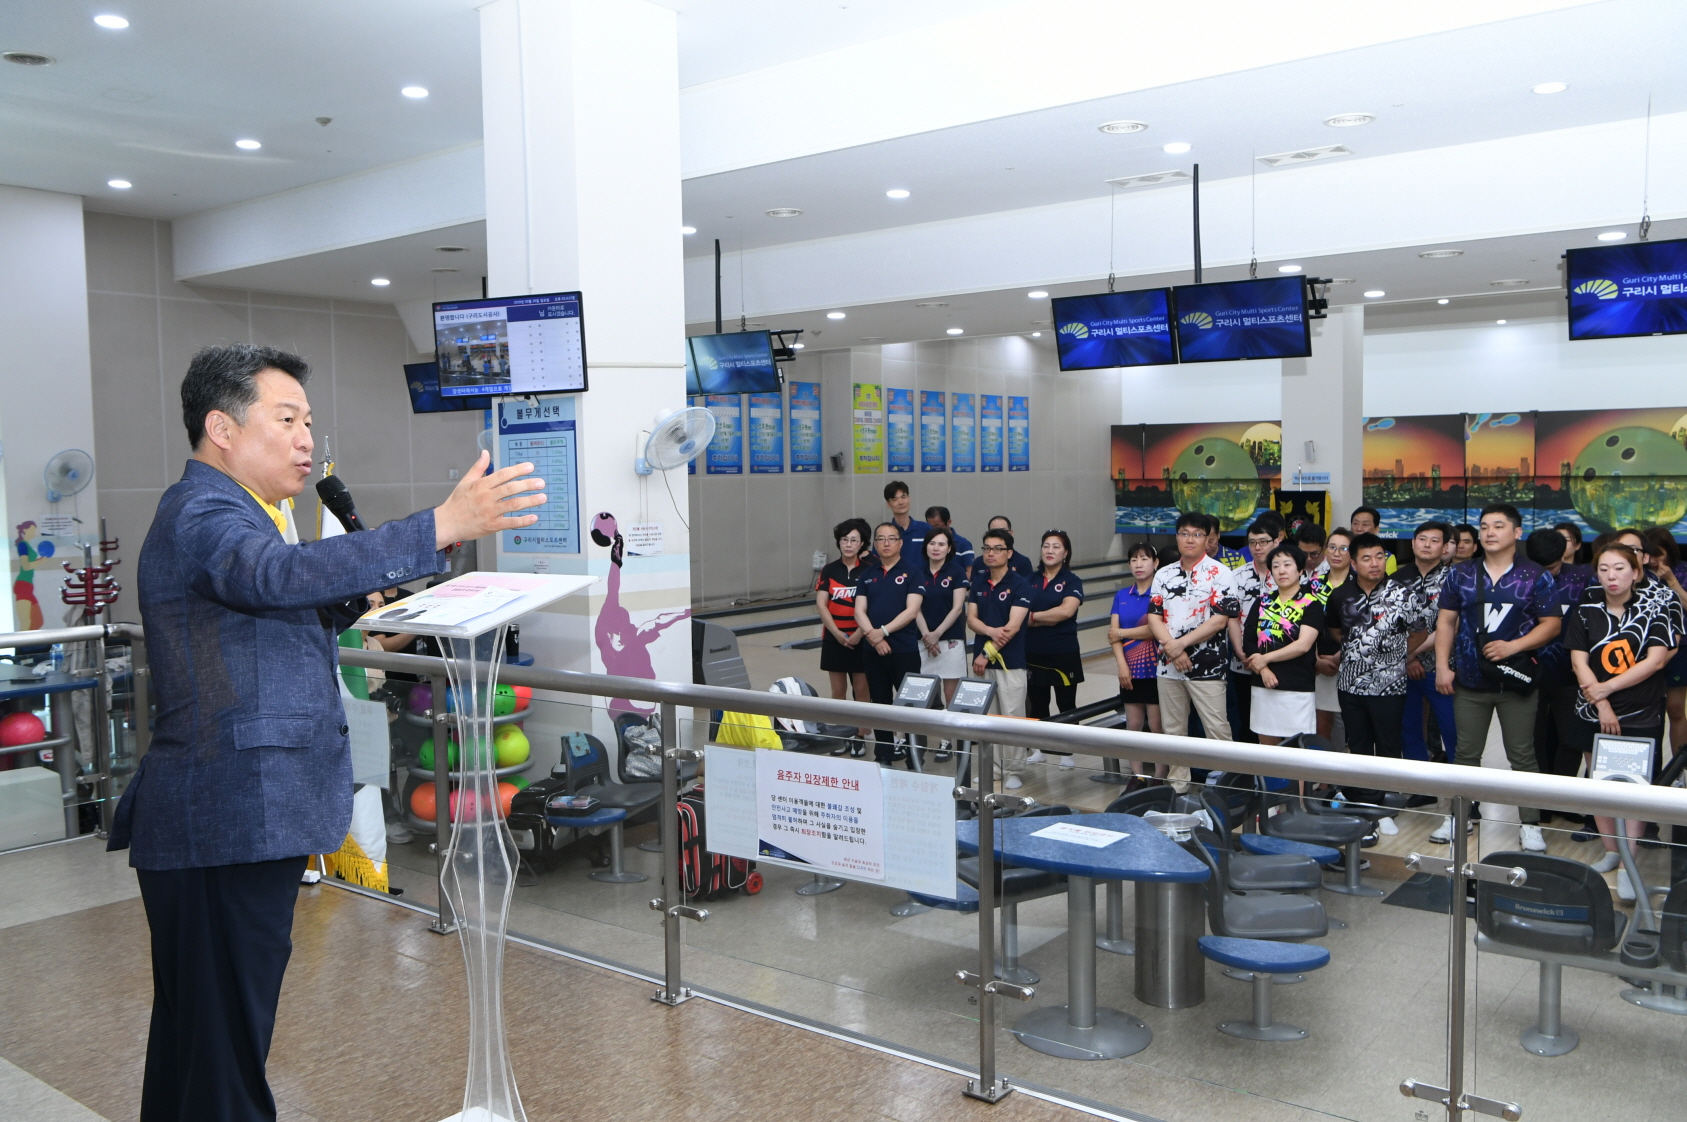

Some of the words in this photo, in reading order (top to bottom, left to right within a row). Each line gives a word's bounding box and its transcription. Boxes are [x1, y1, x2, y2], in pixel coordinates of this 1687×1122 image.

[1622, 285, 1657, 297] 구리시
[1216, 318, 1240, 327] 구리시
[1243, 314, 1302, 325] 멀티스포츠센터
[1091, 327, 1113, 337] 구리시
[1115, 323, 1168, 335] 멀티스포츠센터
[1267, 621, 1280, 630] Pin
[777, 770, 801, 782] 음주자
[804, 773, 838, 787] 입장제한
[842, 778, 859, 791] 안내
[789, 797, 813, 807] 이용객들에
[815, 801, 825, 809] 대한
[827, 802, 843, 811] 불쾌감
[771, 804, 791, 813] 안전사고
[792, 807, 807, 816] 예방을
[821, 811, 841, 821] 주취자의
[843, 814, 858, 824] 이용을
[772, 813, 786, 822] 엄격히
[788, 816, 807, 825] 불허하며
[816, 820, 830, 829] 사실을
[833, 823, 848, 832] 숨기고
[850, 826, 866, 835] 입장한
[790, 826, 799, 834] 즉시
[801, 828, 831, 839] 퇴장조치함을
[833, 833, 866, 845] 알려드립니다.
[1515, 903, 1555, 915] Brunswick
